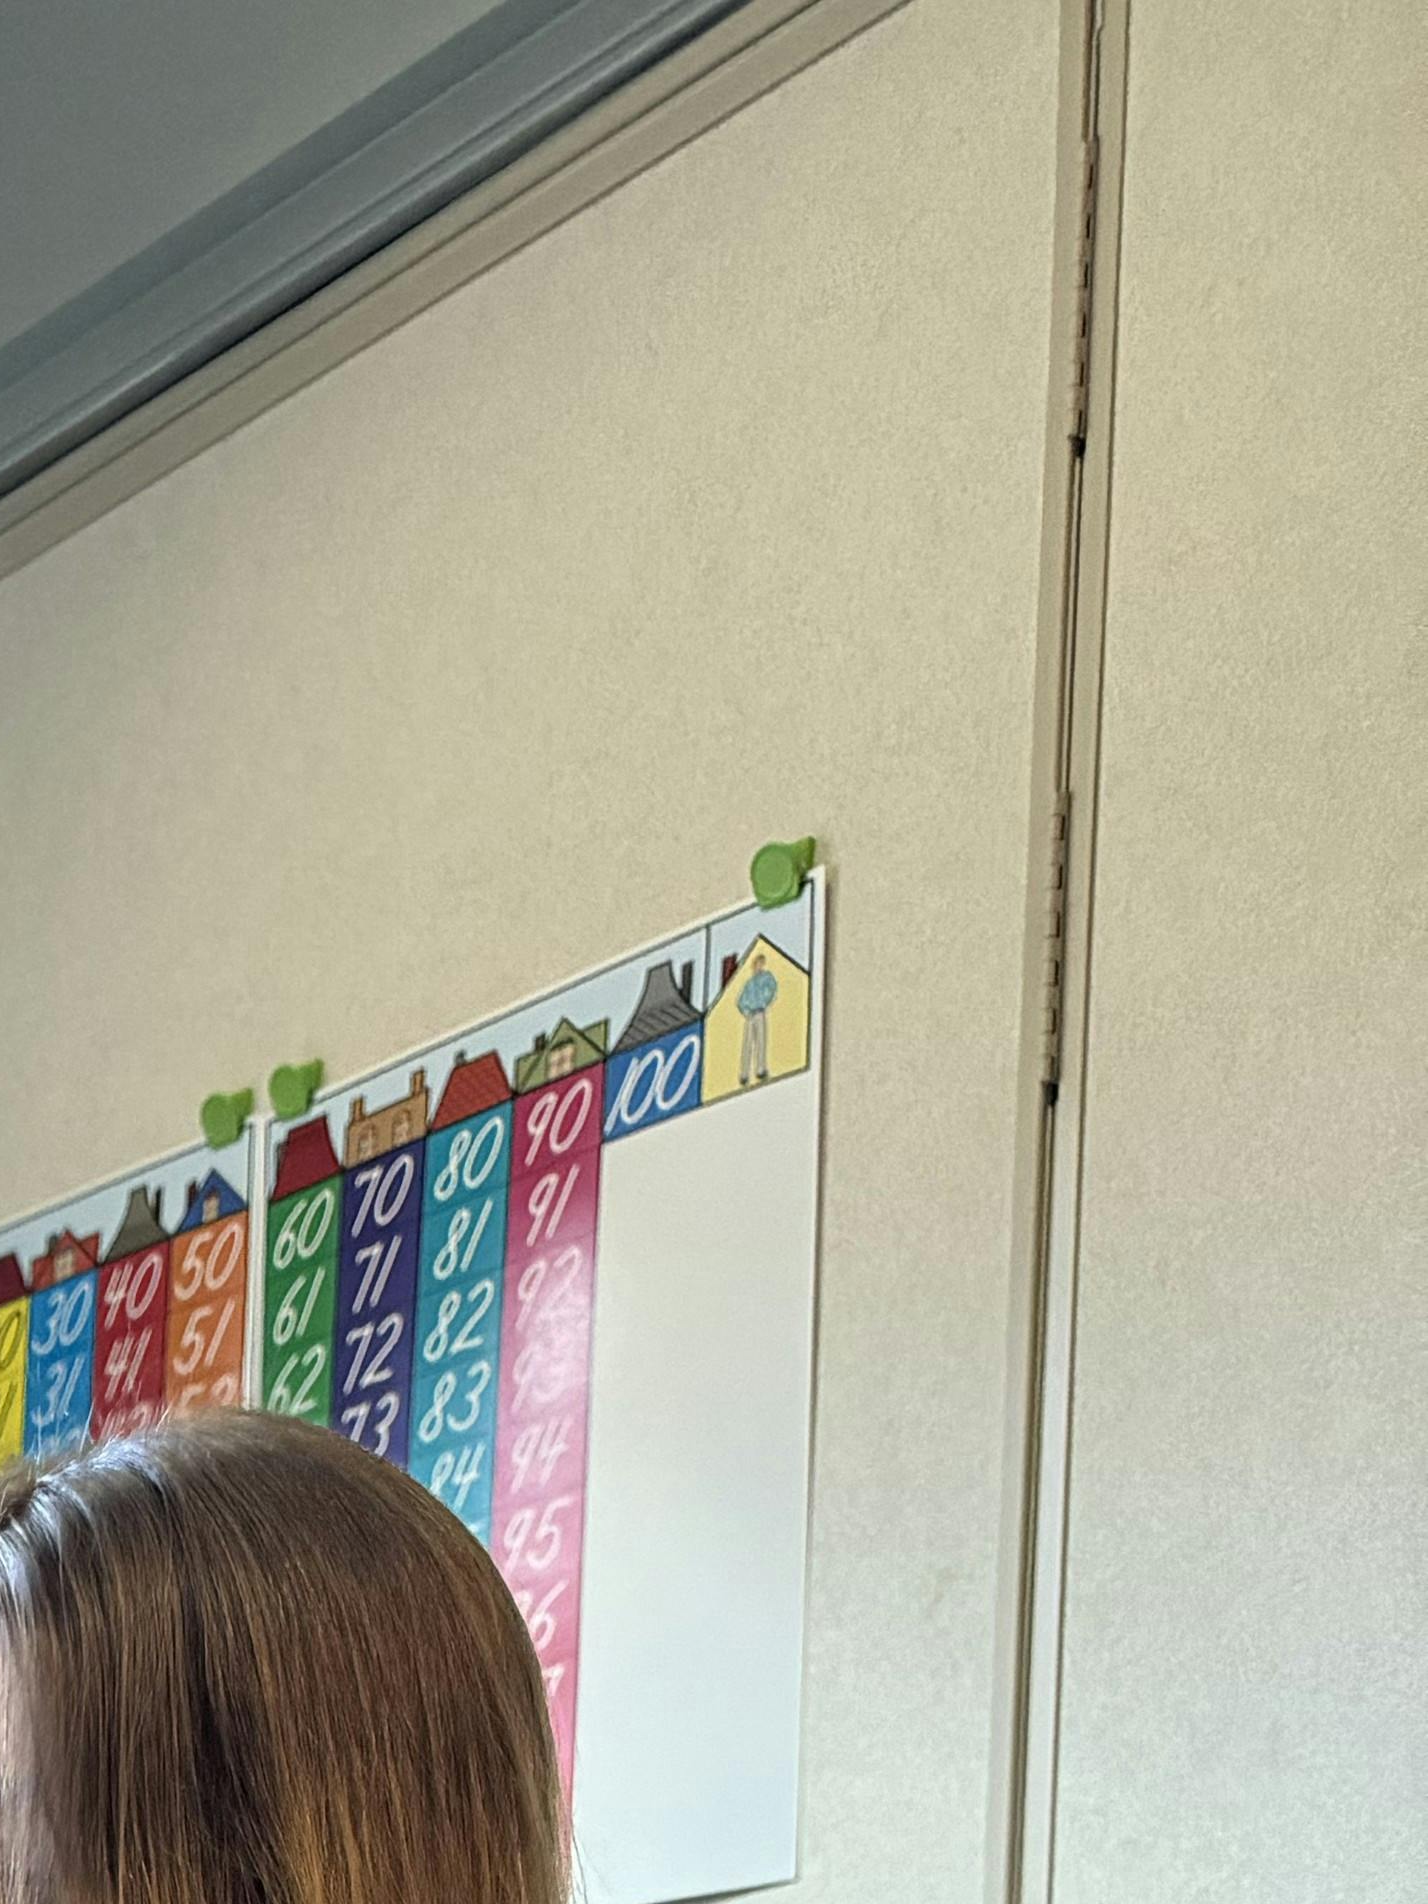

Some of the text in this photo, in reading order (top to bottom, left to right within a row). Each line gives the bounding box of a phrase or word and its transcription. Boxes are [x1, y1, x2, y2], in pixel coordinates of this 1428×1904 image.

[525, 1077, 592, 1166] 90
[603, 1034, 702, 1136] 100
[351, 1154, 415, 1238] 70
[433, 1115, 505, 1201] 80
[273, 1188, 335, 1270] 60
[433, 1197, 494, 1280] 81
[526, 1163, 581, 1248] 91
[103, 1253, 164, 1330] 40
[173, 1222, 243, 1300] 50
[351, 1234, 403, 1314] 71
[30, 1281, 92, 1355] 30
[172, 1298, 236, 1375] 51
[272, 1266, 326, 1345] 61
[422, 1279, 495, 1363] 82
[30, 1356, 85, 1427] 31
[103, 1328, 153, 1401] 41
[267, 1343, 326, 1416] 62
[343, 1313, 406, 1395] 72
[418, 1361, 492, 1443] 83
[510, 1417, 573, 1494] 94
[503, 1496, 574, 1574] 95
